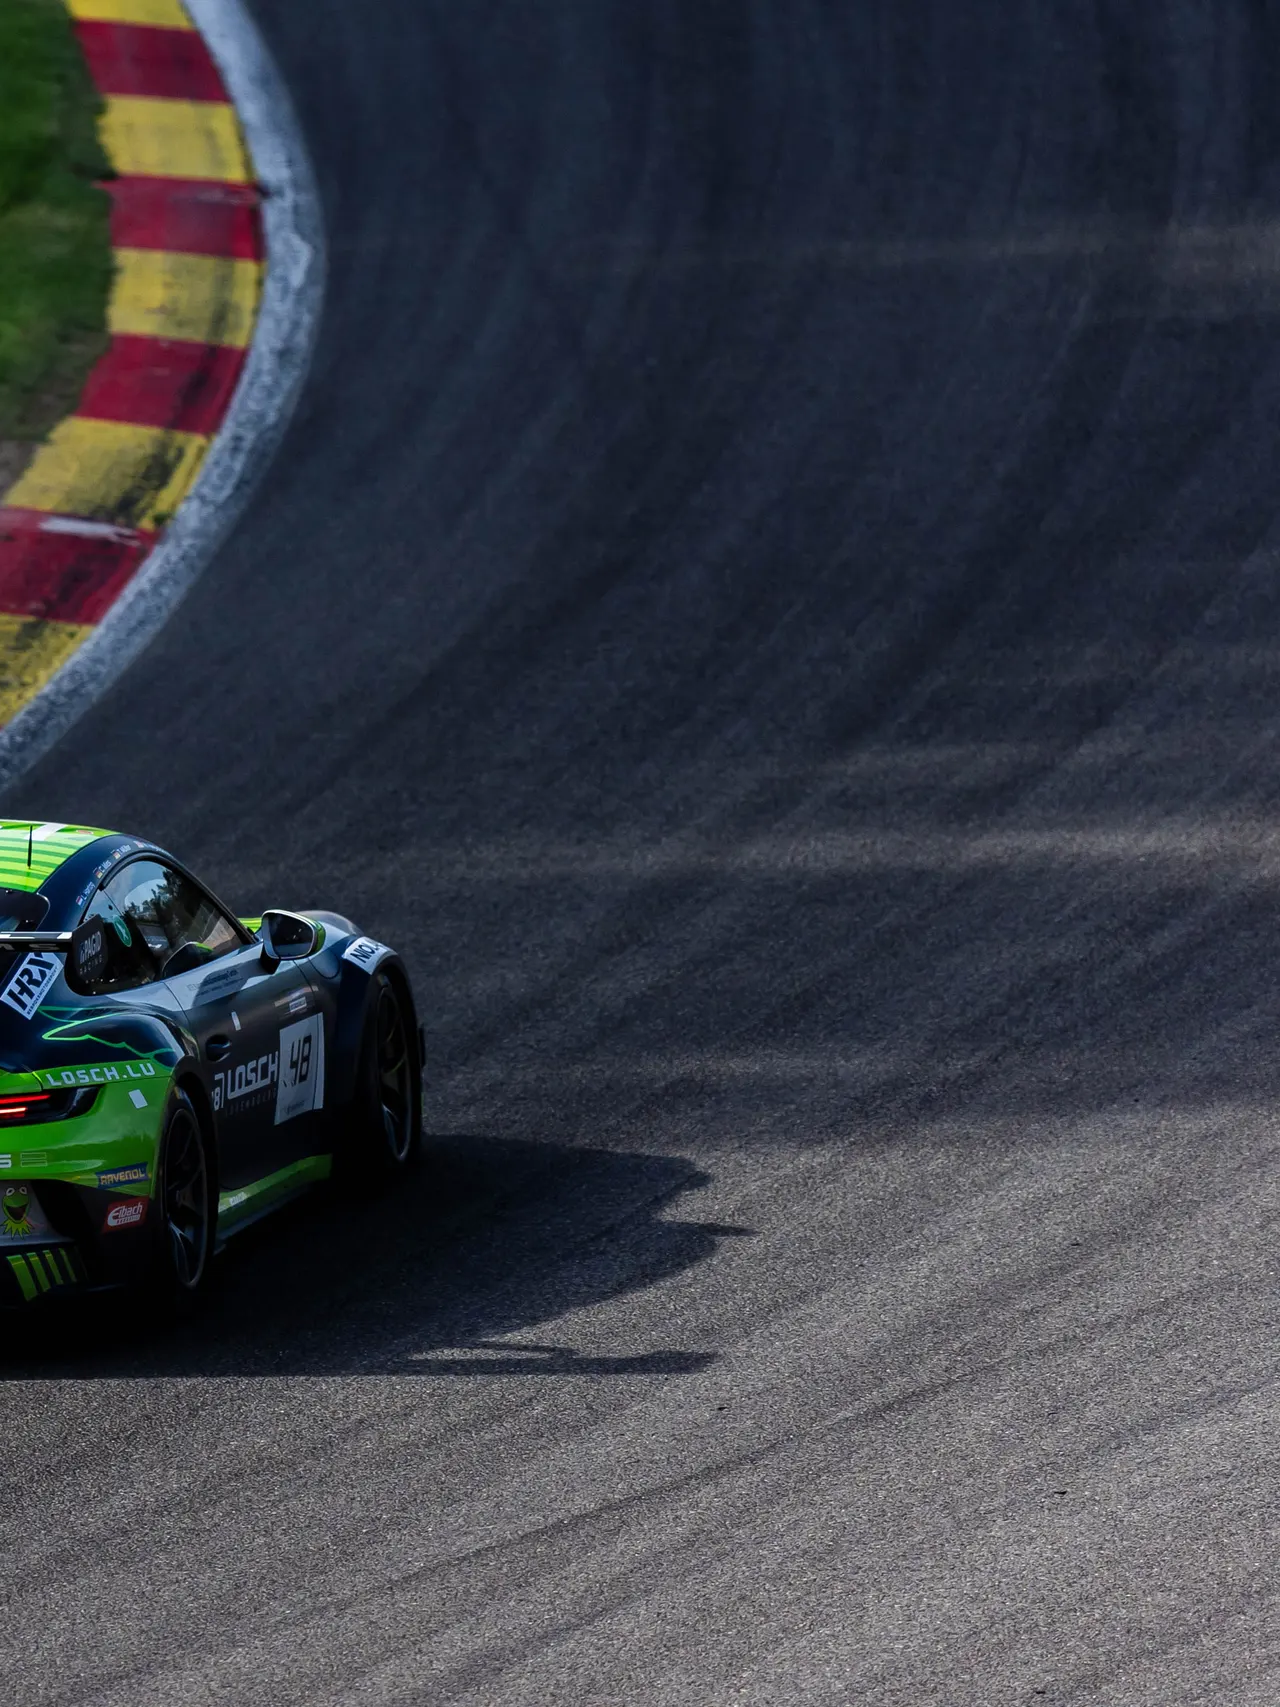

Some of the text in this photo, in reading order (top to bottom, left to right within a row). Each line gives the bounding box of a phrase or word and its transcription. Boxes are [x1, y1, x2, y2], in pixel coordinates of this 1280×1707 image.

[45, 1062, 155, 1087] LOSCH.LU
[227, 1051, 279, 1100] LOSCH
[290, 1034, 312, 1086] 48
[100, 1168, 145, 1185] RAVENOL
